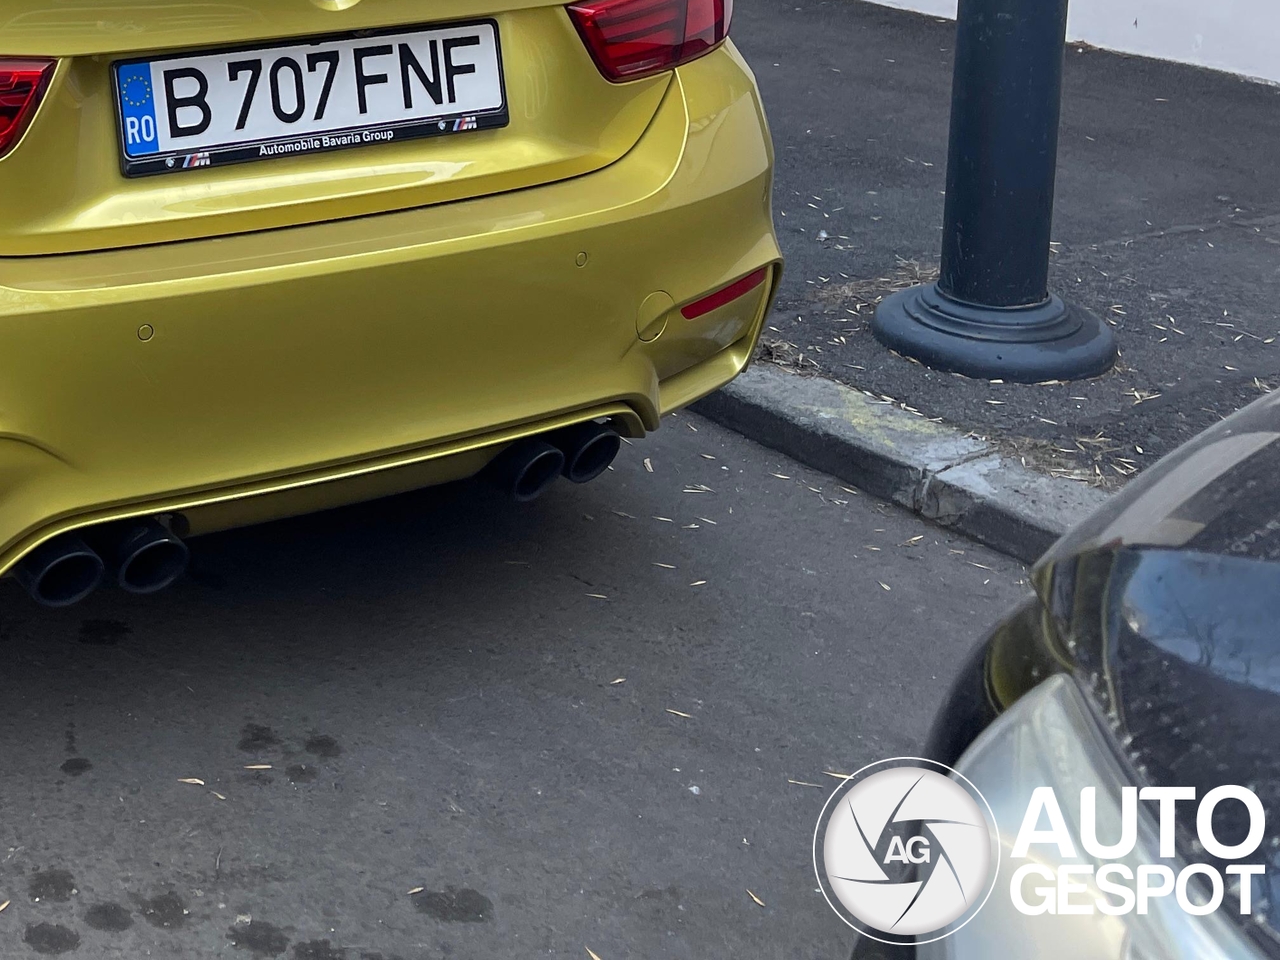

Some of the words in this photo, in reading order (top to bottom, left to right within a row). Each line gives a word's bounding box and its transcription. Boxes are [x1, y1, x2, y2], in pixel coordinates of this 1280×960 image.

[163, 67, 213, 139] B
[227, 50, 340, 131] 707
[352, 35, 481, 115] FNF
[125, 114, 156, 145] RO
[259, 137, 321, 156] Automobile
[322, 132, 361, 148] Bavaria
[362, 129, 394, 141] Group
